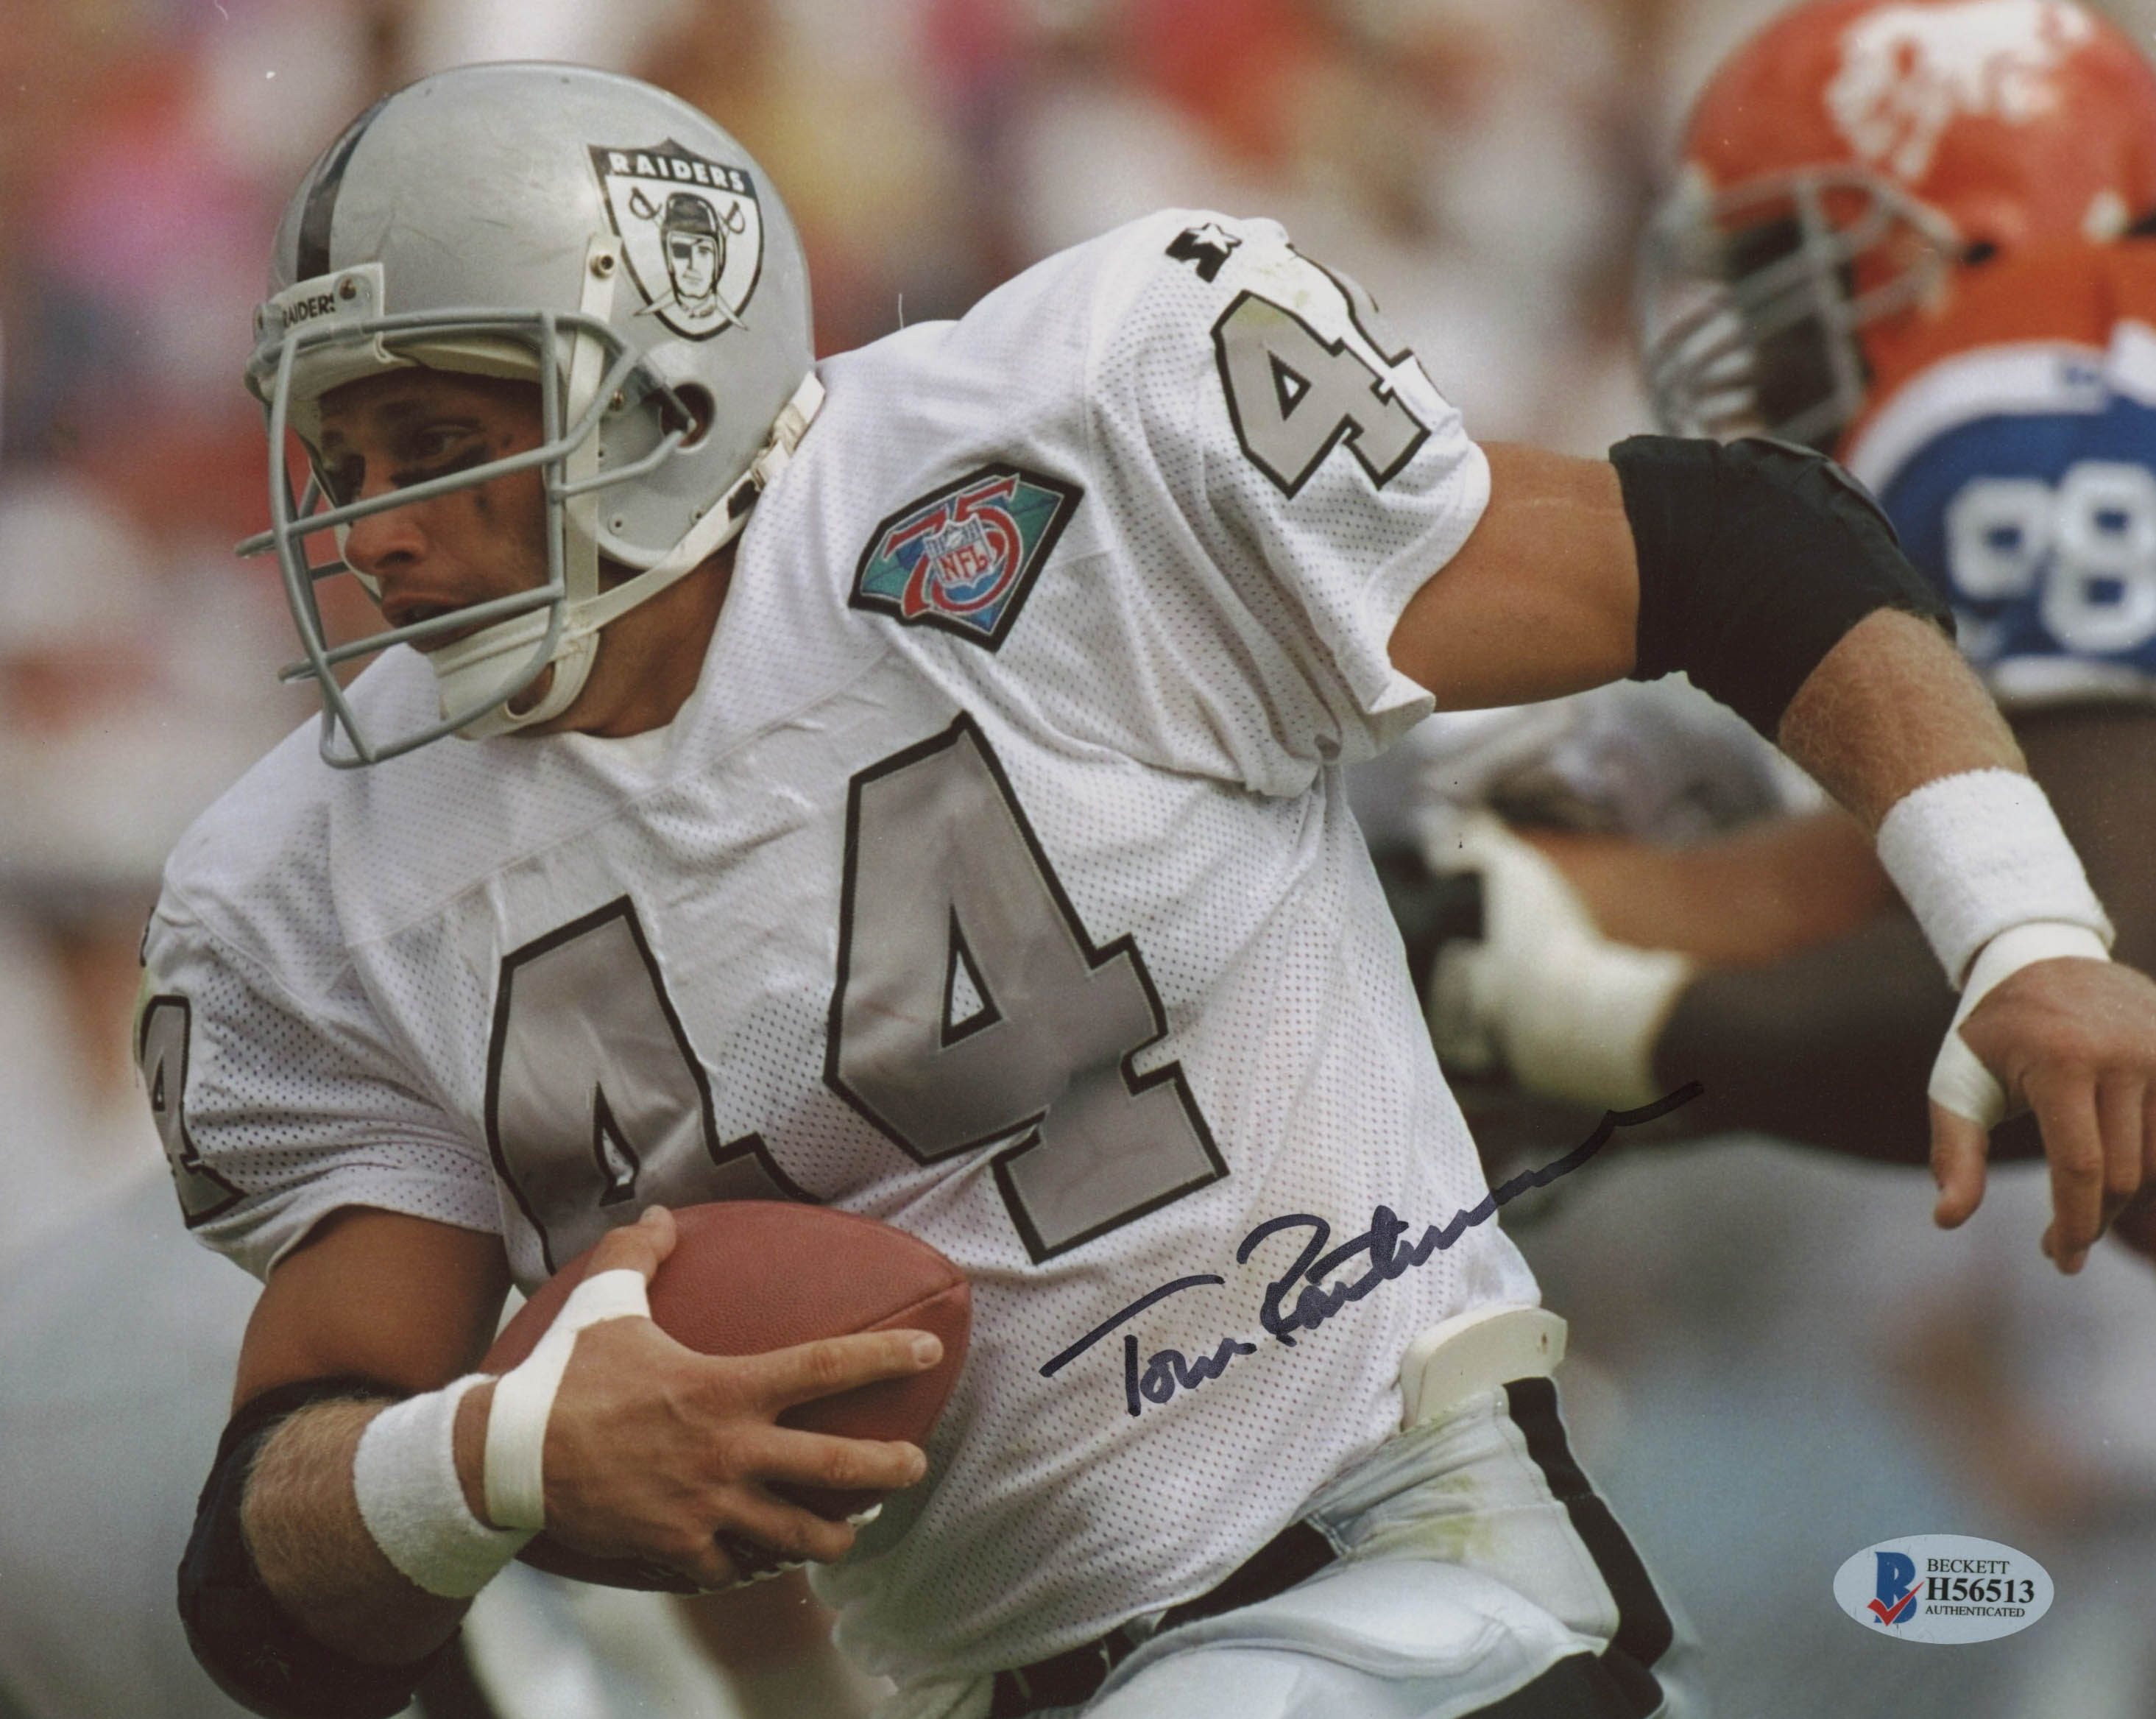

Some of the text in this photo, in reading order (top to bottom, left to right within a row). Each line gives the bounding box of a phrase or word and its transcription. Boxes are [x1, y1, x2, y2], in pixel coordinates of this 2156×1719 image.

[607, 151, 746, 194] RAIDERS
[939, 543, 992, 582] NFL
[1039, 1273, 1258, 1418] Tom
